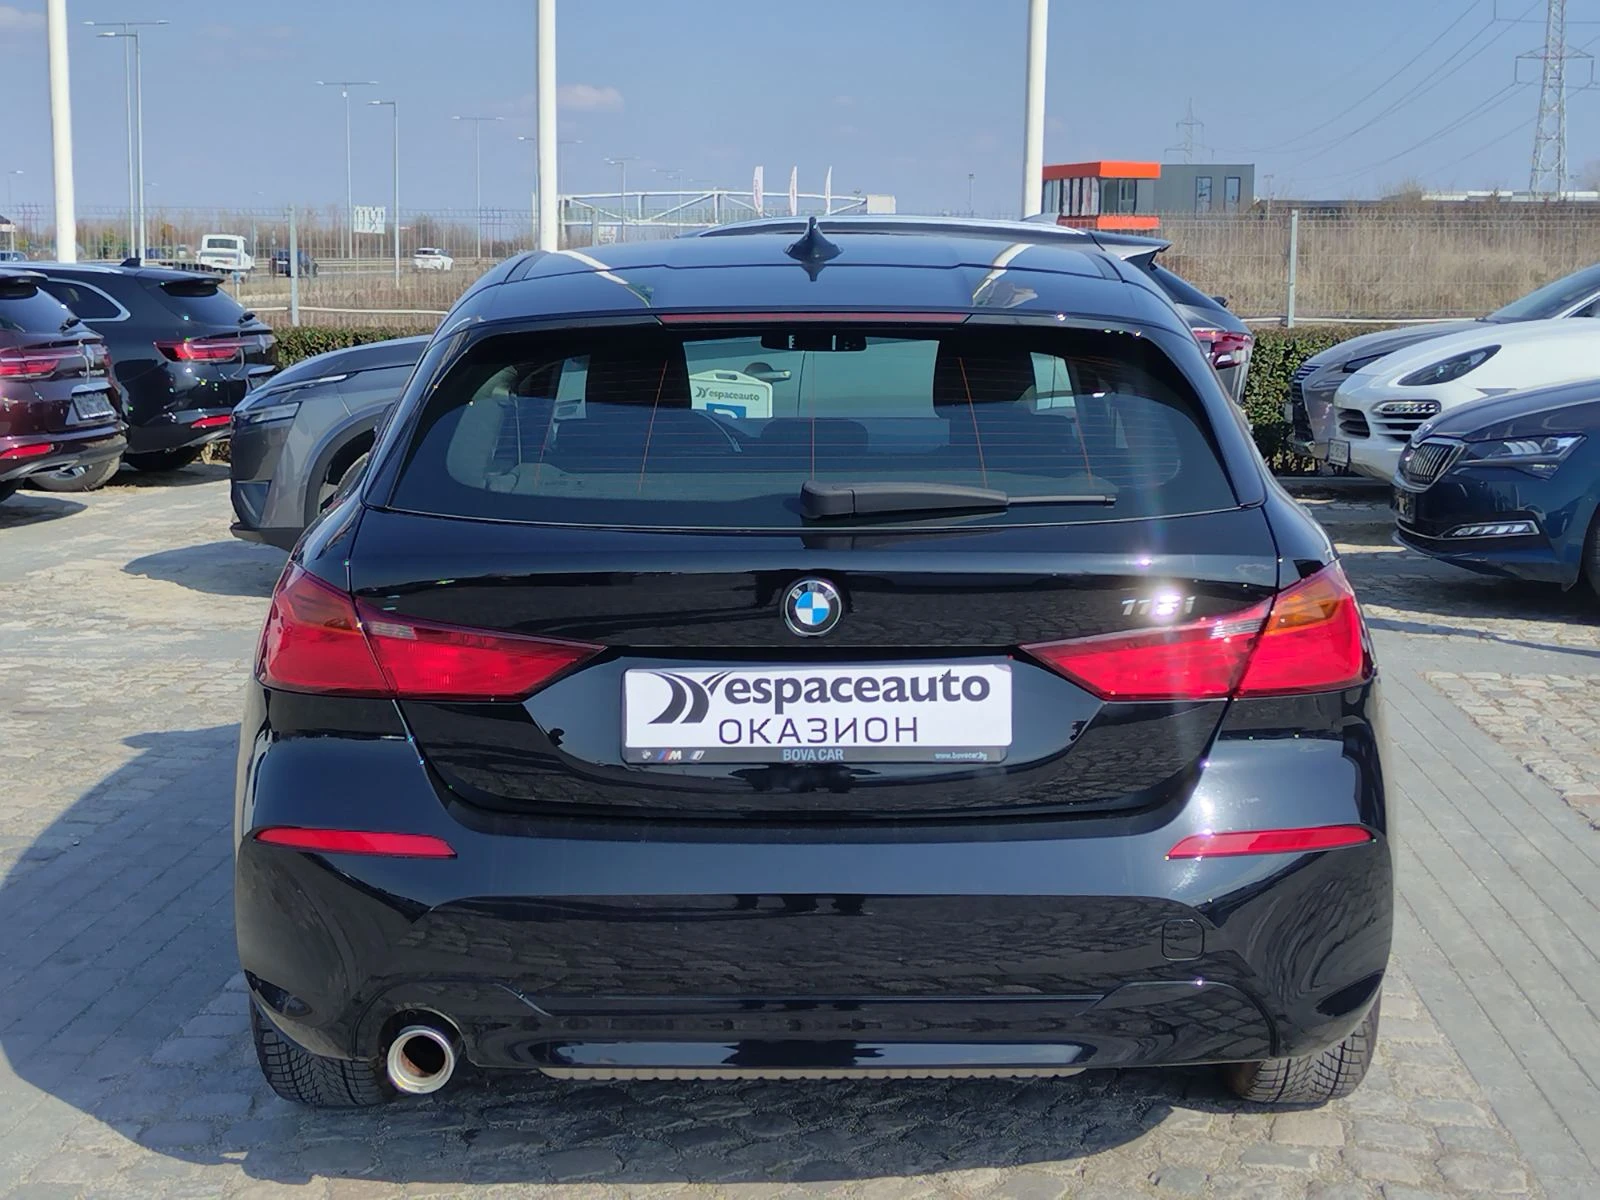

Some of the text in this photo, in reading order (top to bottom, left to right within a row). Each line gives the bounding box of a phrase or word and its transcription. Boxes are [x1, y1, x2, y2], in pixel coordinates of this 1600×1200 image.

[709, 390, 760, 401] espaceauto
[724, 669, 991, 715] espaceauto
[718, 717, 918, 745] ОКАЗИОН
[783, 749, 844, 761] BOVA CAR
